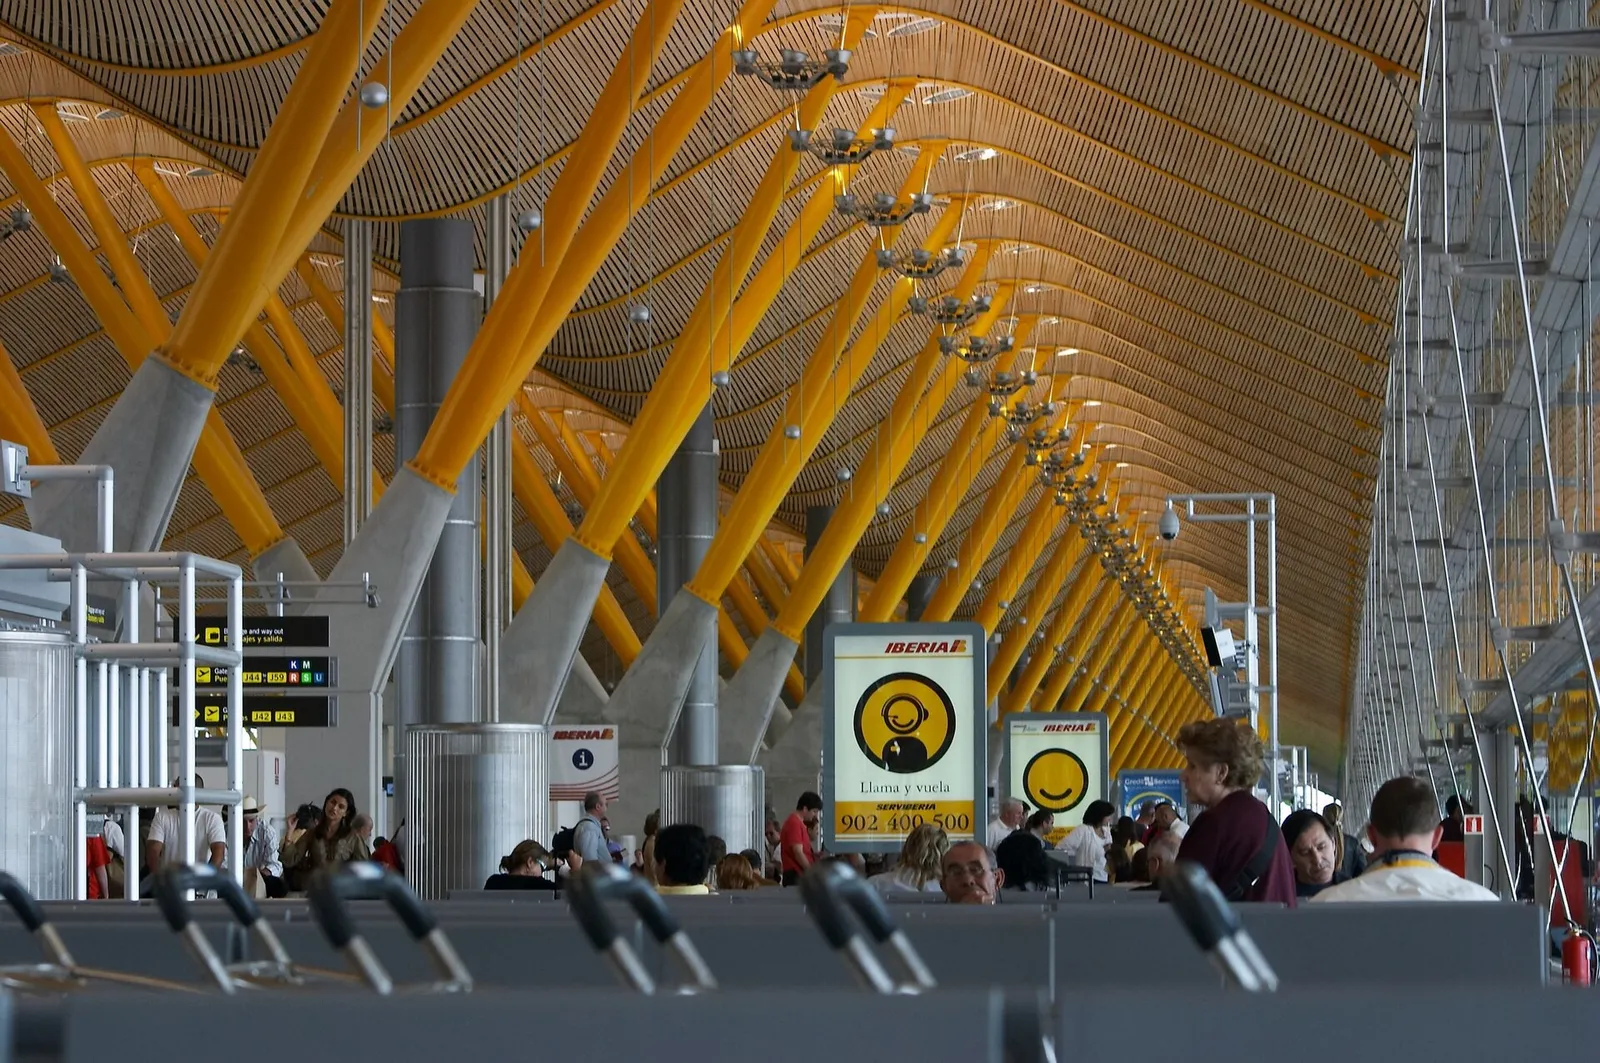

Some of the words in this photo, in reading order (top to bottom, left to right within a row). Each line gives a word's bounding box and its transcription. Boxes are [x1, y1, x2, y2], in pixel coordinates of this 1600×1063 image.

[263, 635, 283, 643] salida
[884, 642, 949, 653] IBERIA
[290, 660, 298, 669] K
[302, 660, 311, 669] M
[244, 673, 260, 682] J44
[270, 673, 285, 682] J59
[291, 673, 298, 682] R
[303, 673, 310, 681] S
[254, 712, 270, 721] J42
[277, 712, 293, 721] J43
[1043, 724, 1084, 732] IBERIA
[553, 730, 600, 740] IBERIA
[860, 781, 900, 794] Llama
[904, 784, 913, 797] y
[916, 780, 950, 794] vuela
[876, 803, 937, 811] SERVIBERIA
[841, 813, 878, 833] 902
[887, 812, 924, 831] 400
[933, 812, 970, 831] 500
